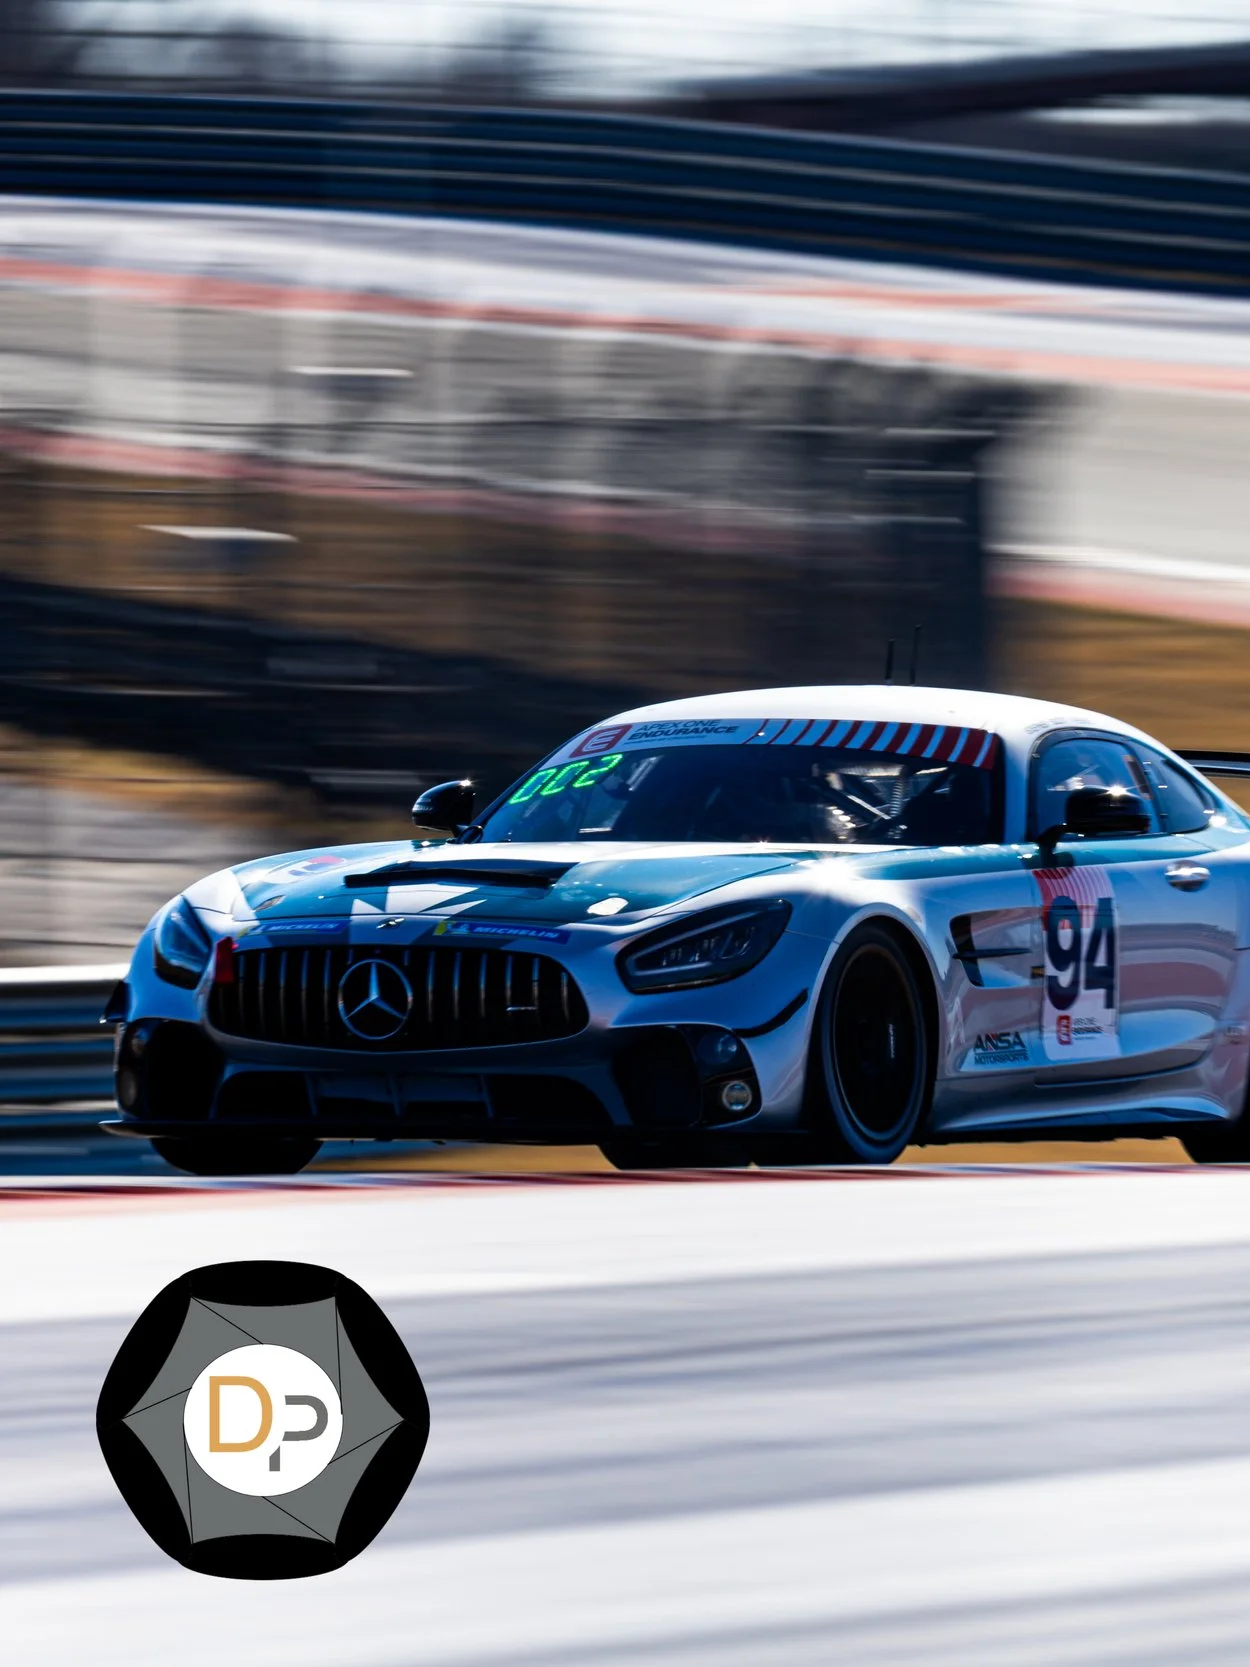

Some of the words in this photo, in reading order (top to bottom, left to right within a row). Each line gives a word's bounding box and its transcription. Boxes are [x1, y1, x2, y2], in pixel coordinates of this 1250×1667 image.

[637, 721, 683, 732] APEX
[684, 719, 722, 728] ONE
[628, 726, 739, 741] ENDURANCE
[508, 753, 624, 805] 002
[473, 926, 560, 939] MICHELIN
[1047, 895, 1115, 1011] 94
[974, 1031, 1026, 1051] ANSA
[974, 1053, 1030, 1065] MOTORSPORTS
